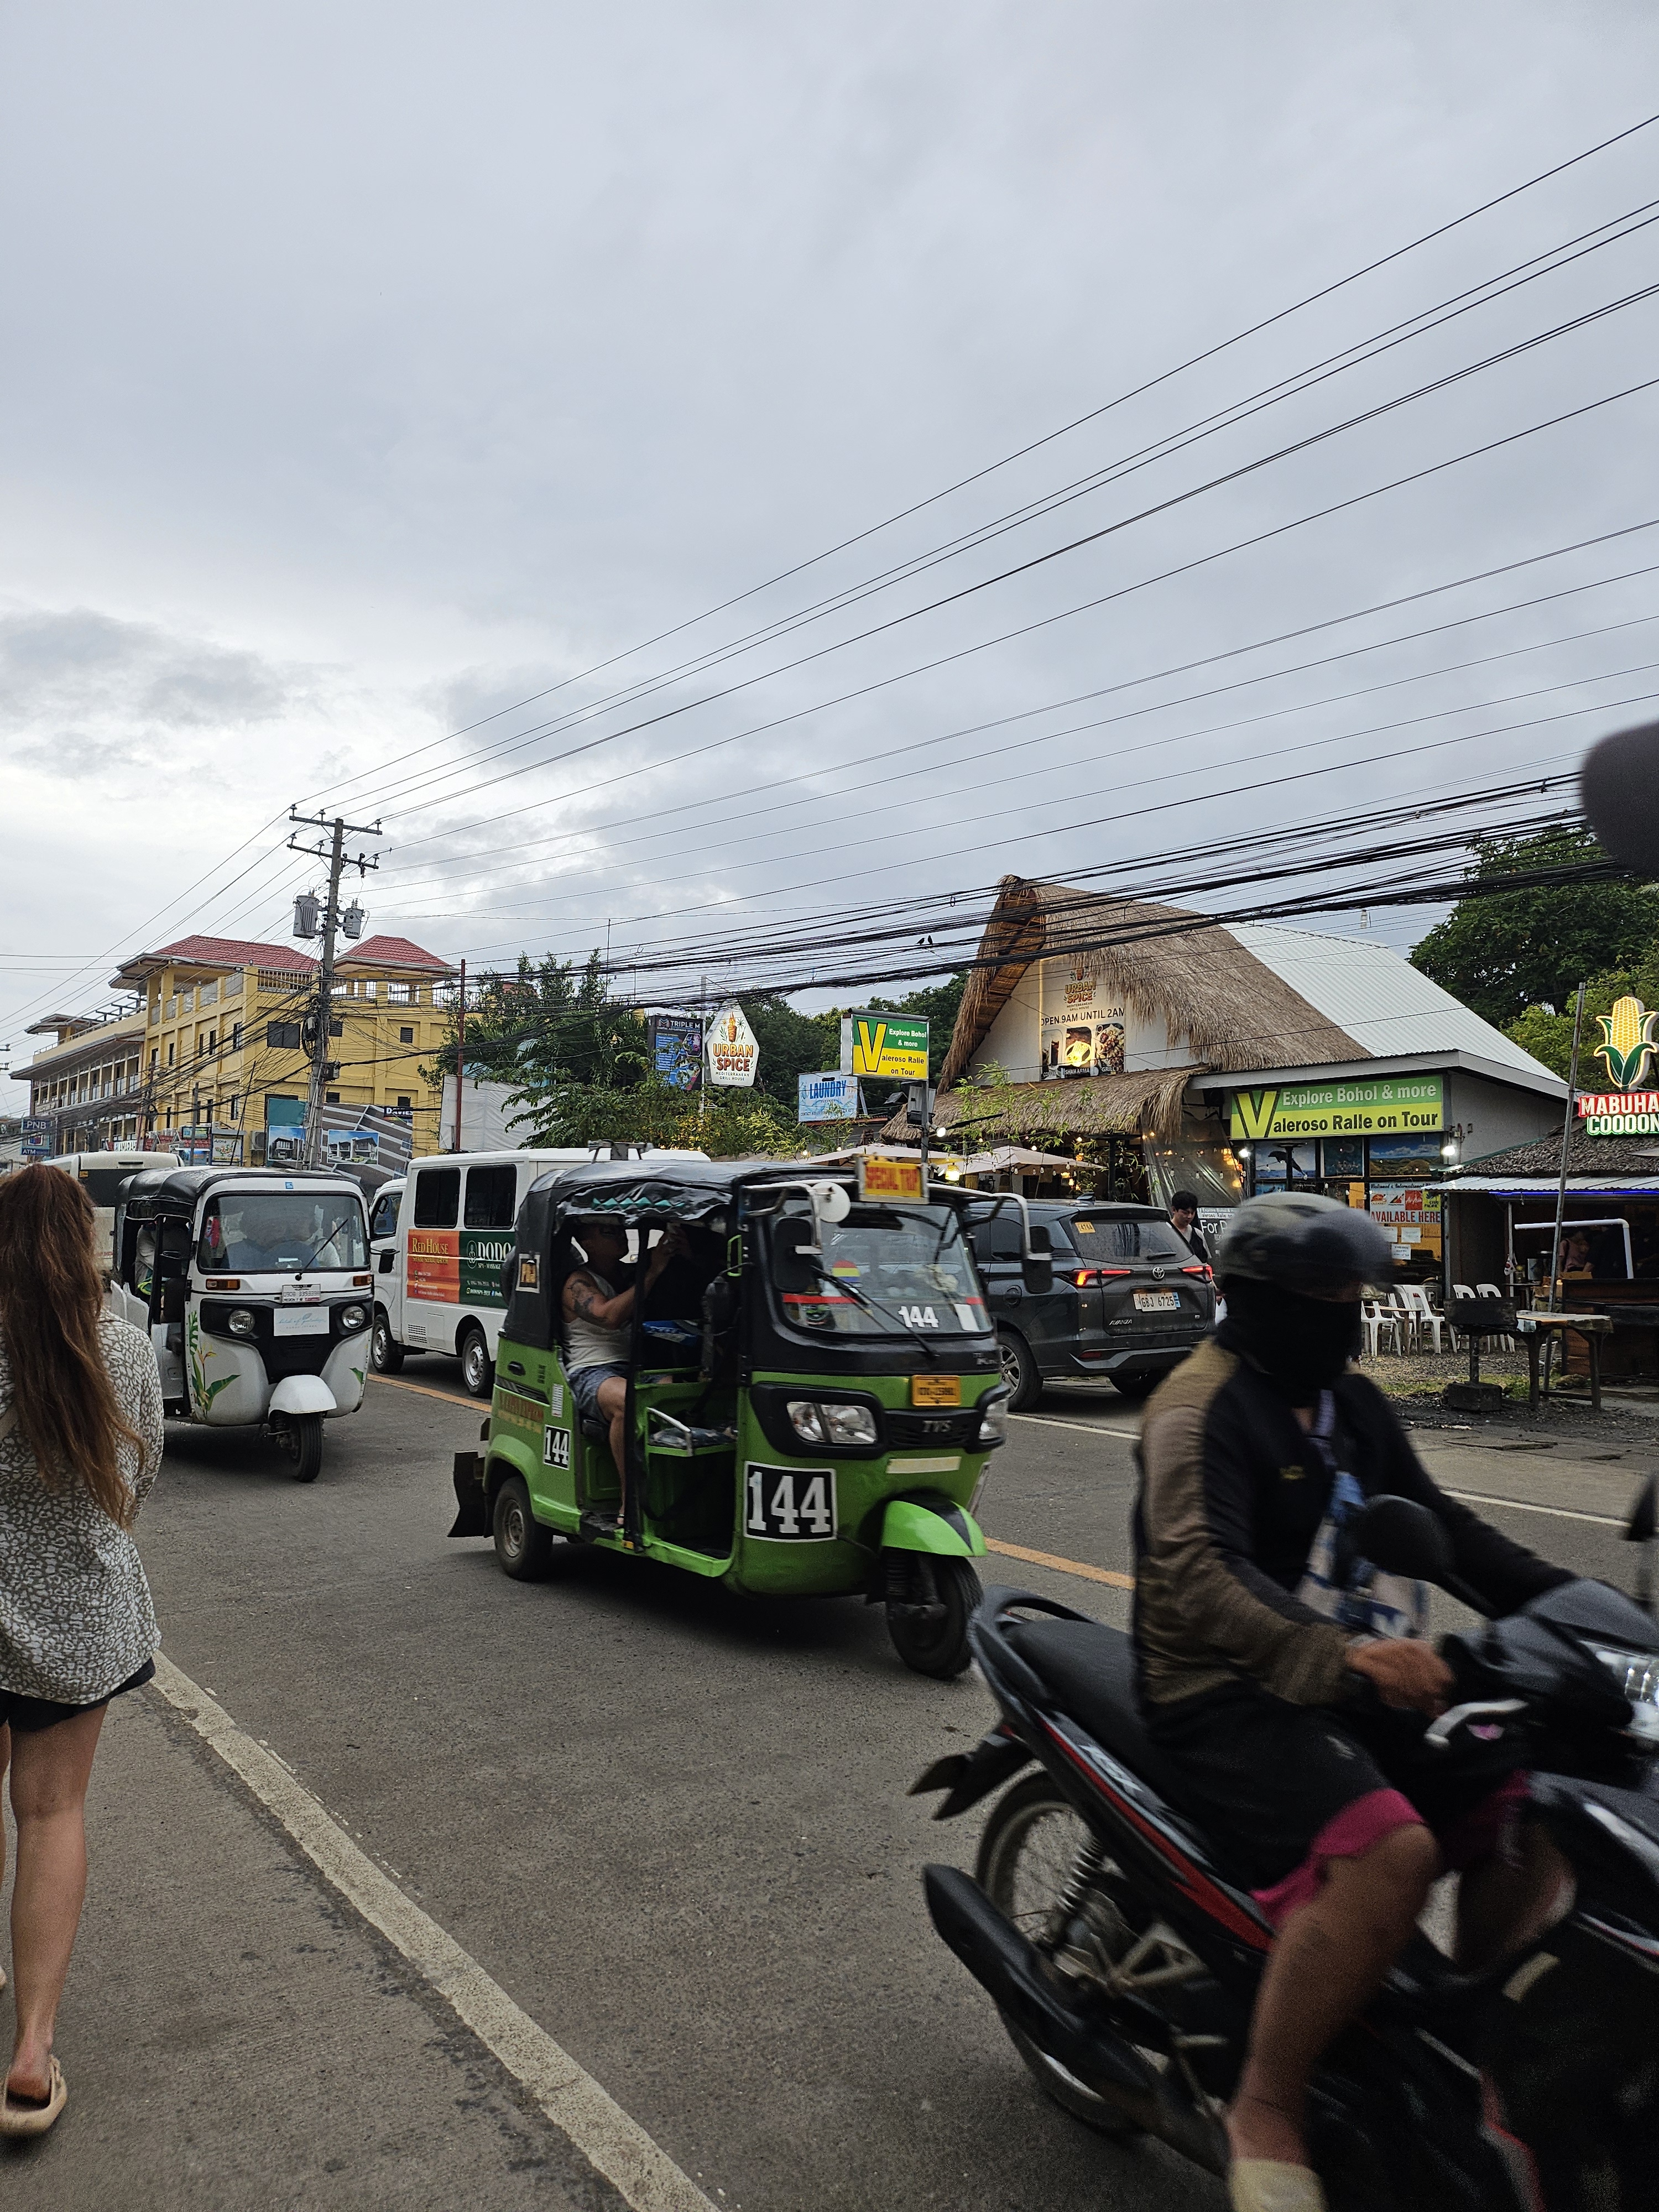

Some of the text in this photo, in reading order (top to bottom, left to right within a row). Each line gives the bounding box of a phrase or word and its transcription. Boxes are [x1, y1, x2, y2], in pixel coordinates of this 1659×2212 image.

[1065, 980, 1097, 994] URBAN
[1067, 991, 1093, 1004] SPICE
[1061, 1013, 1078, 1023] 9AM
[1081, 1010, 1105, 1021] UNTIL
[889, 1029, 910, 1037] Explore
[713, 1044, 753, 1057] URBAN
[717, 1057, 750, 1072] SPICE
[810, 1080, 847, 1099] LAUNDRY
[1282, 1084, 1437, 1108] Explore Bohol & more
[1580, 1094, 1659, 1115] MABUHA
[26, 1120, 47, 1129] PNB
[1332, 1113, 1373, 1130] Ralle
[1377, 1114, 1397, 1128] on
[1401, 1111, 1438, 1128] Tour
[1371, 1211, 1441, 1223] AVAILABLE HERE
[1199, 1219, 1218, 1234] For
[412, 1238, 448, 1254] RED HOUSE
[1141, 1296, 1175, 1308] GBJ 6725
[898, 1306, 939, 1328] 144
[544, 1429, 569, 1465] 144
[748, 1471, 831, 1533] 144
